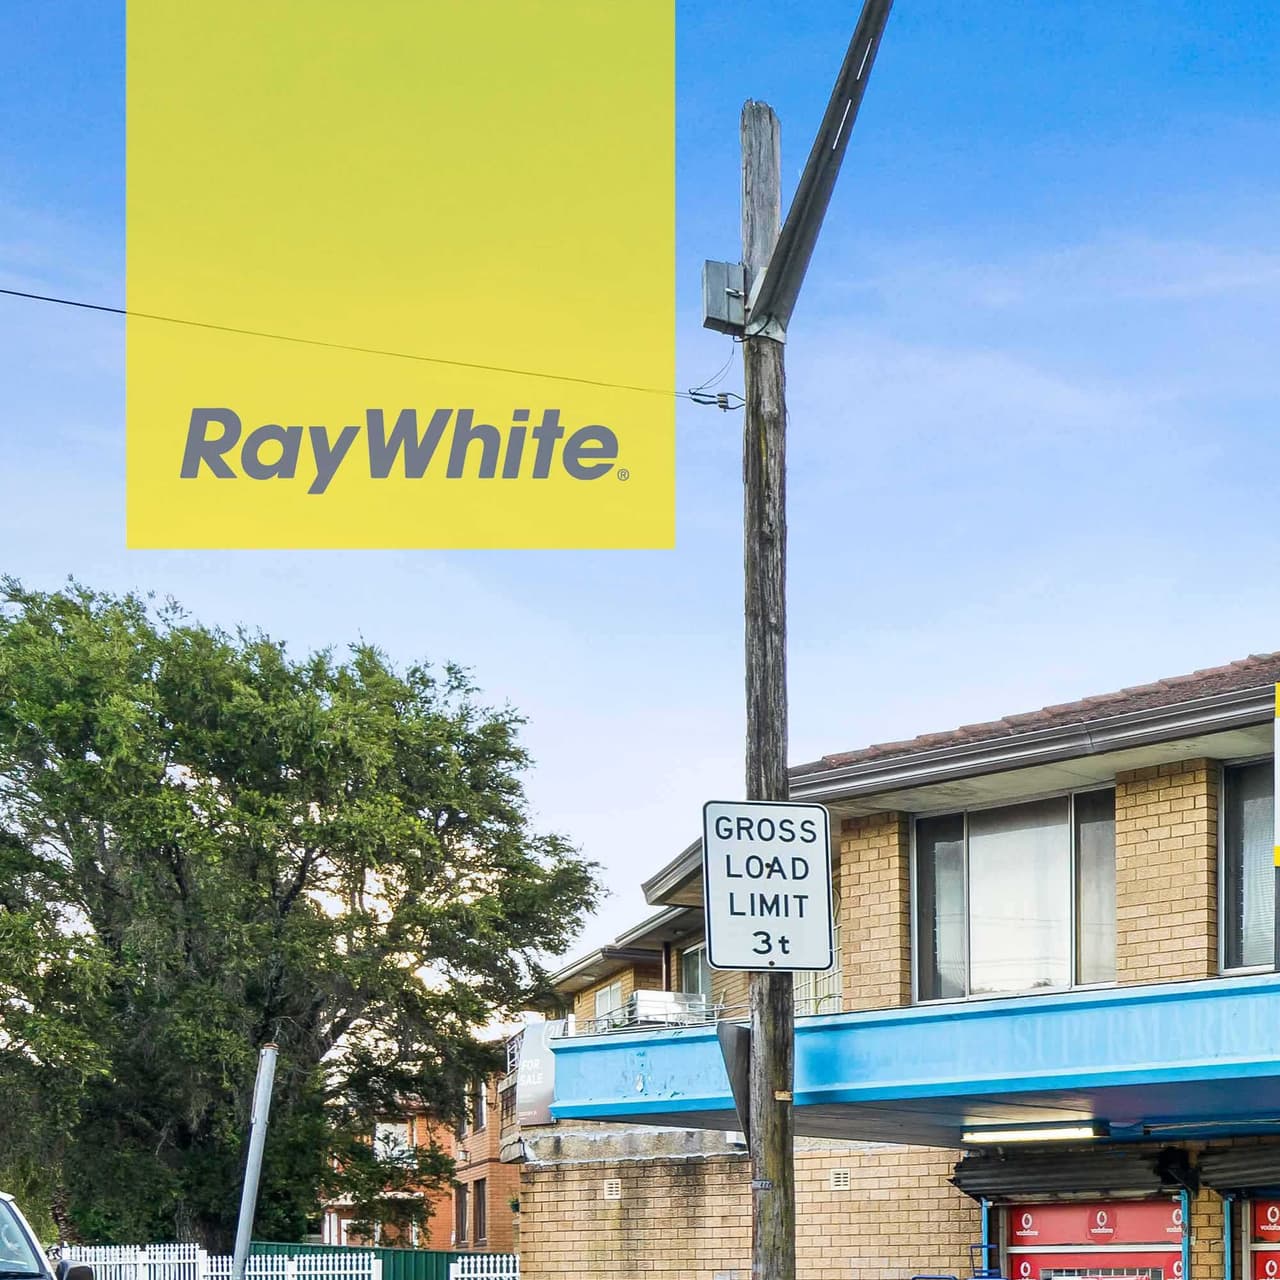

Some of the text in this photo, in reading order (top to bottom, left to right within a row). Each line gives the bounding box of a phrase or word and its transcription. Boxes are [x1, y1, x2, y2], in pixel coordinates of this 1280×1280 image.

[715, 816, 817, 843] GROSS
[726, 855, 809, 880] LOAD
[729, 892, 809, 918] LIMIT
[522, 1060, 540, 1071] FOR
[520, 1073, 543, 1086] SALE
